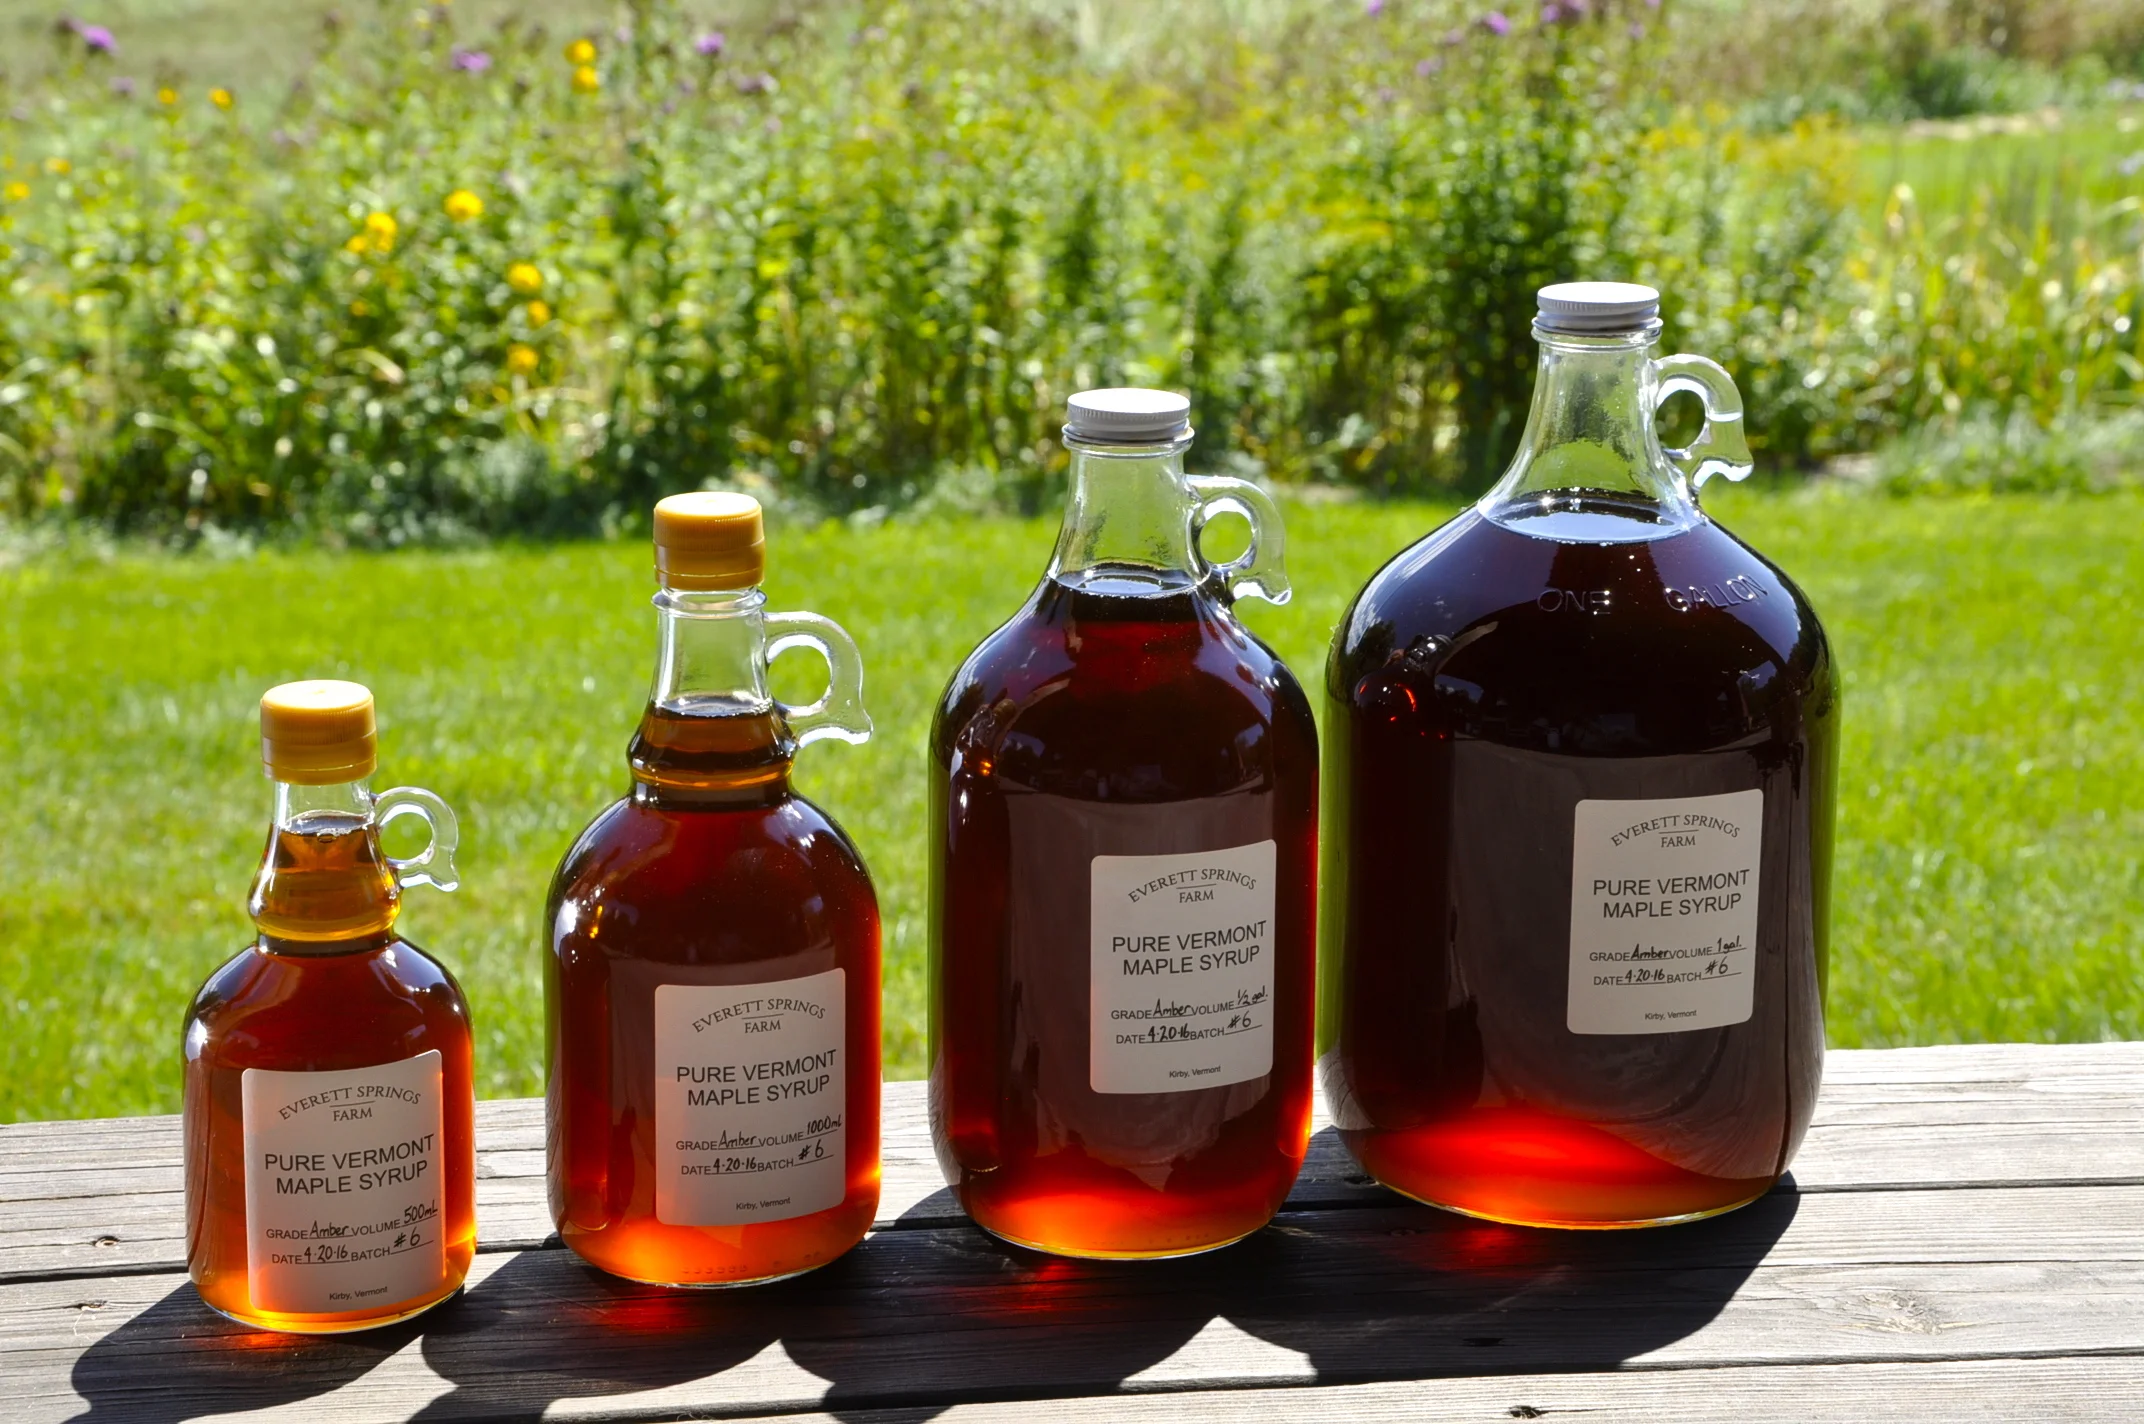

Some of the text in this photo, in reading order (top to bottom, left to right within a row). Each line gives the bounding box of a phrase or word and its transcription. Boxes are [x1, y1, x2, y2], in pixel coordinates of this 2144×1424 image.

[1537, 575, 1768, 615] ONE GALLON
[1611, 815, 1740, 846] EVERETT SPRINGS
[1661, 836, 1696, 847] FARM
[1128, 868, 1256, 903] EVERETT SPRINGS
[1593, 869, 1749, 895] PURE VERMONT
[1179, 890, 1214, 903] FARM
[1603, 893, 1741, 918] MAPLE SYRUP
[1112, 920, 1266, 952] PURE VERMONT
[1123, 945, 1260, 975] MAPLE SYRUP
[1590, 952, 1630, 961] GRADE
[1631, 944, 1670, 960] Amber
[1670, 947, 1713, 959] VOLUME
[1594, 976, 1623, 985] DATE
[1667, 972, 1701, 983] BATCH
[692, 999, 825, 1033] EVERETT SPRINGS
[1111, 1010, 1151, 1019] GRADE
[1153, 998, 1192, 1016] Amber
[1192, 1001, 1234, 1015] VOLUME
[1645, 1010, 1697, 1021] Kirby, Vermont
[745, 1020, 781, 1033] FARM
[1116, 1035, 1145, 1044] DATE
[1190, 1028, 1225, 1040] BATCH
[677, 1049, 836, 1082] PURE VERMONT
[1169, 1065, 1221, 1078] Kirby, Vermont
[688, 1075, 830, 1106] MAPLE SYRUP
[278, 1086, 421, 1120] EVERETT SPRINGS
[333, 1108, 372, 1121] FARM
[676, 1141, 717, 1150] GRADE
[718, 1130, 758, 1147] Amber
[758, 1132, 804, 1146] VOLUME
[265, 1134, 434, 1171] PURE VERMONT
[277, 1160, 427, 1194] MAPLE SYRUP
[682, 1165, 711, 1175] DATE
[757, 1159, 794, 1172] BATCH
[736, 1197, 791, 1210] Kirby, Vermont
[266, 1229, 308, 1239] GRADE
[310, 1220, 349, 1237] Amber
[351, 1219, 401, 1236] VOLUME
[272, 1254, 302, 1264] DATE
[351, 1248, 390, 1261] BATCH
[330, 1286, 388, 1300] Kirby, Vermont
